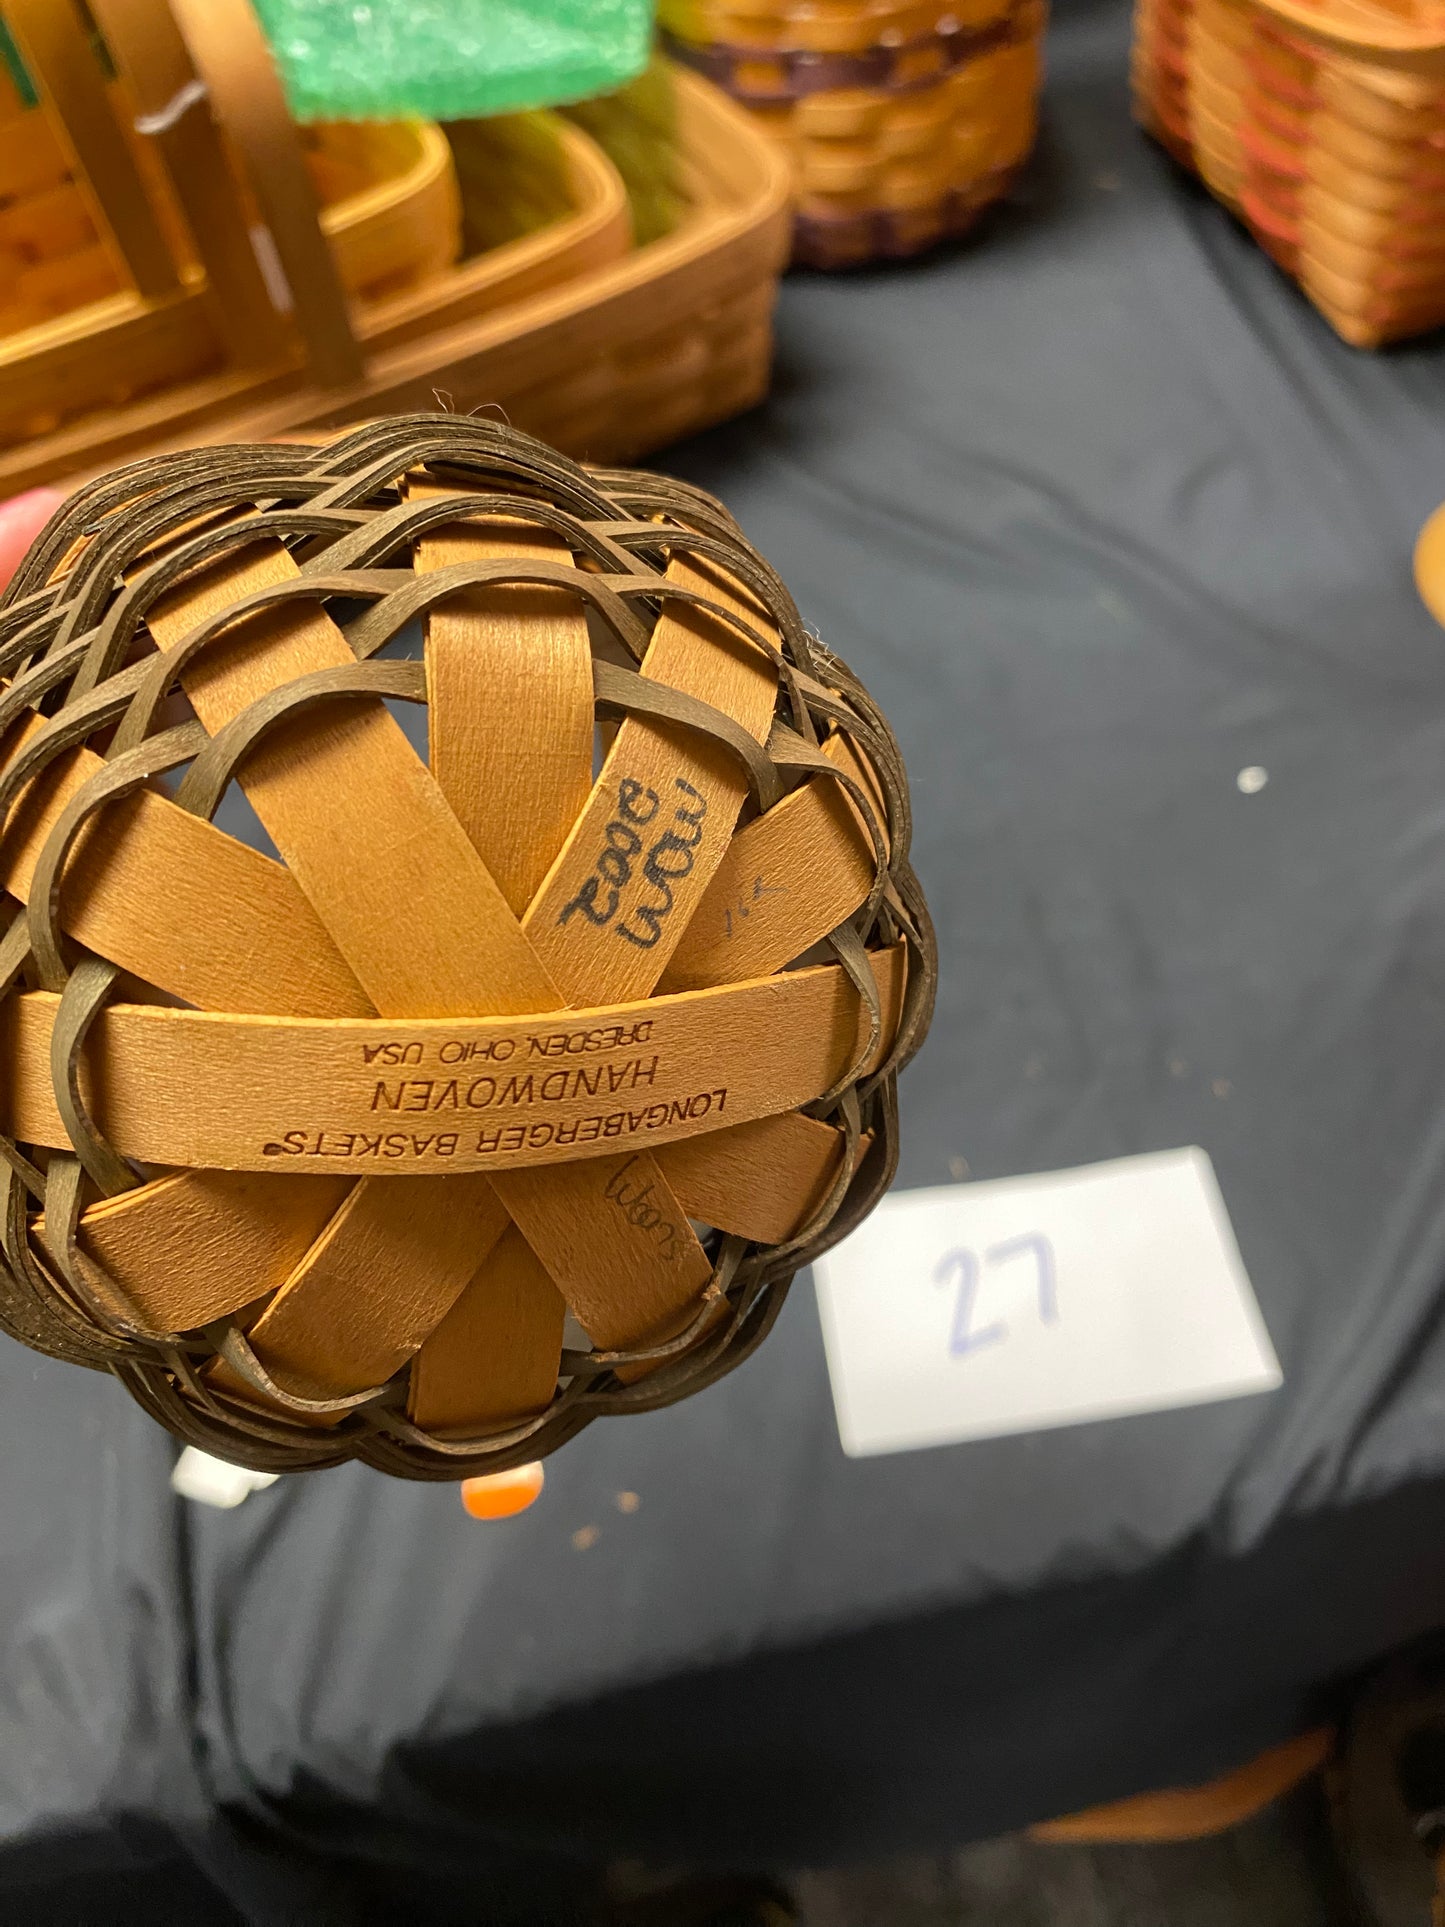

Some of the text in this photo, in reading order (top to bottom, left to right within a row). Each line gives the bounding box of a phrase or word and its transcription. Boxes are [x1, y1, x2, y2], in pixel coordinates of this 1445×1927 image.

[556, 777, 660, 927] 2002
[362, 1019, 655, 1066] DRESDEN, OHIO USA
[370, 1055, 660, 1111] HANDWOVEN
[475, 1088, 729, 1154] LONGABERGER
[932, 1229, 1060, 1360] 27
